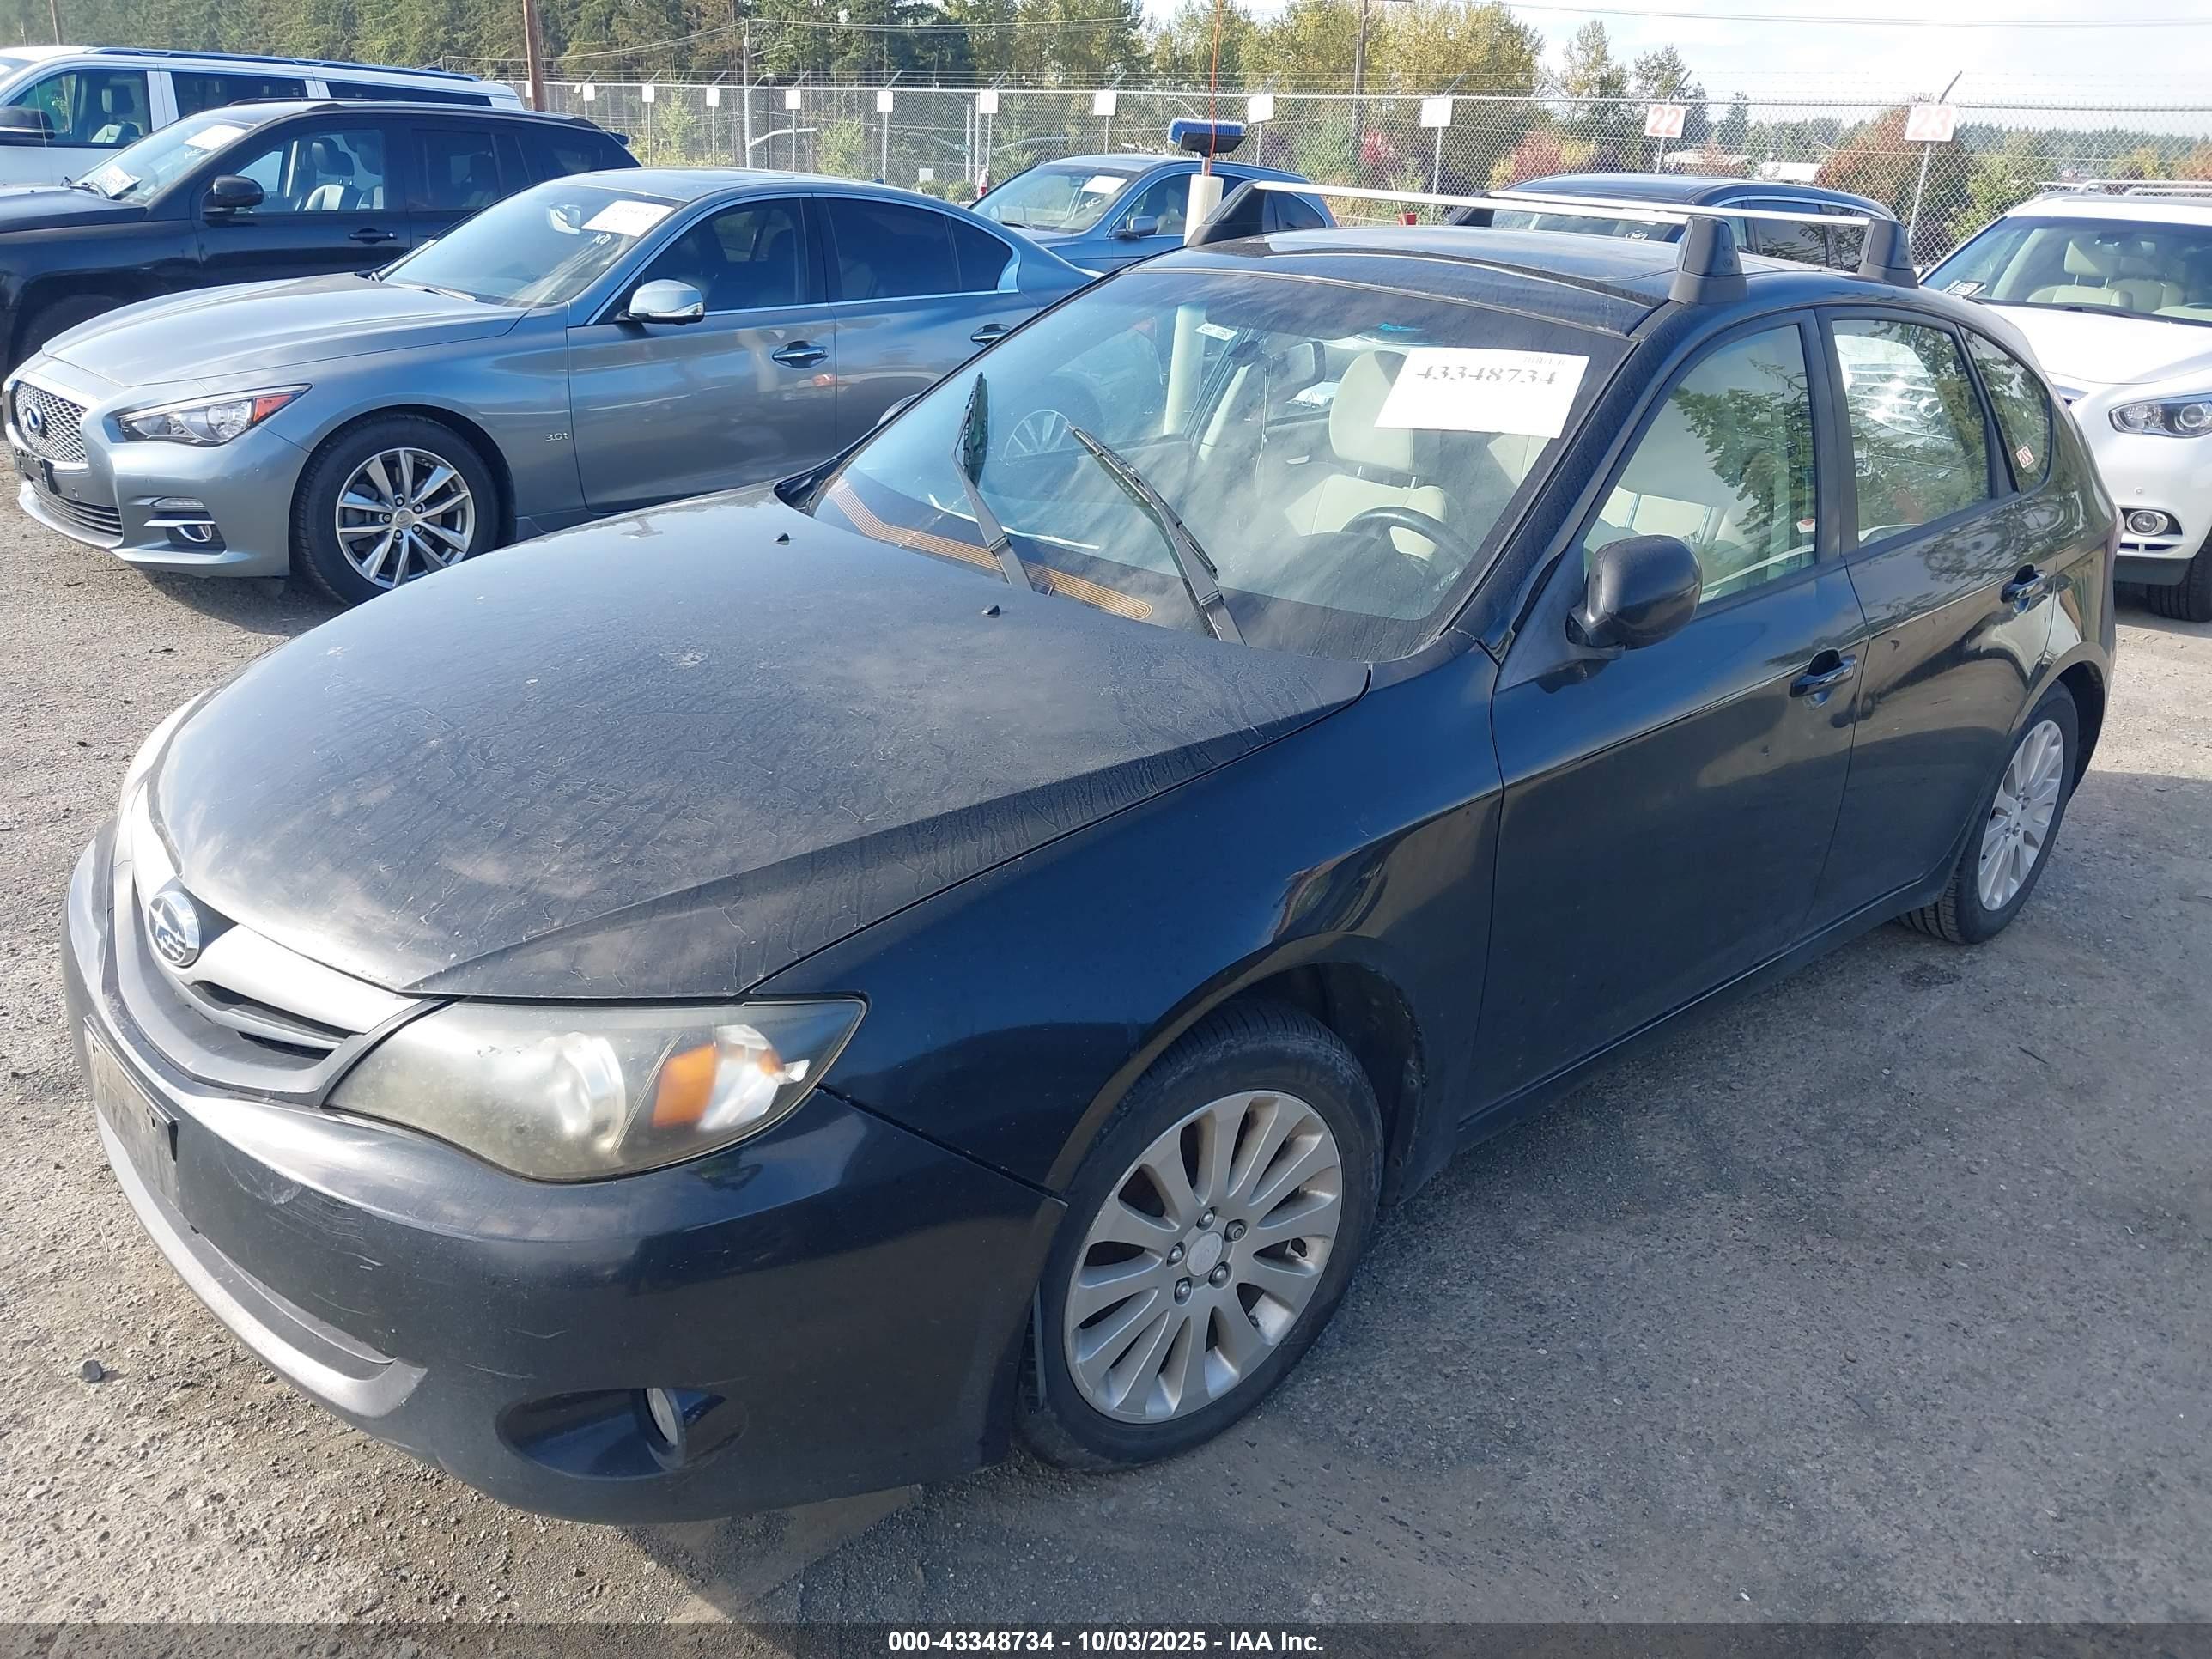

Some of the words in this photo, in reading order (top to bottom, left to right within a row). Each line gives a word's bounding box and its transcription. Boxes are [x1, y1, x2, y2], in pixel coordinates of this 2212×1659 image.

[1650, 106, 1680, 135] 22
[1911, 107, 1952, 138] 23
[1416, 365, 1559, 385] 43348734
